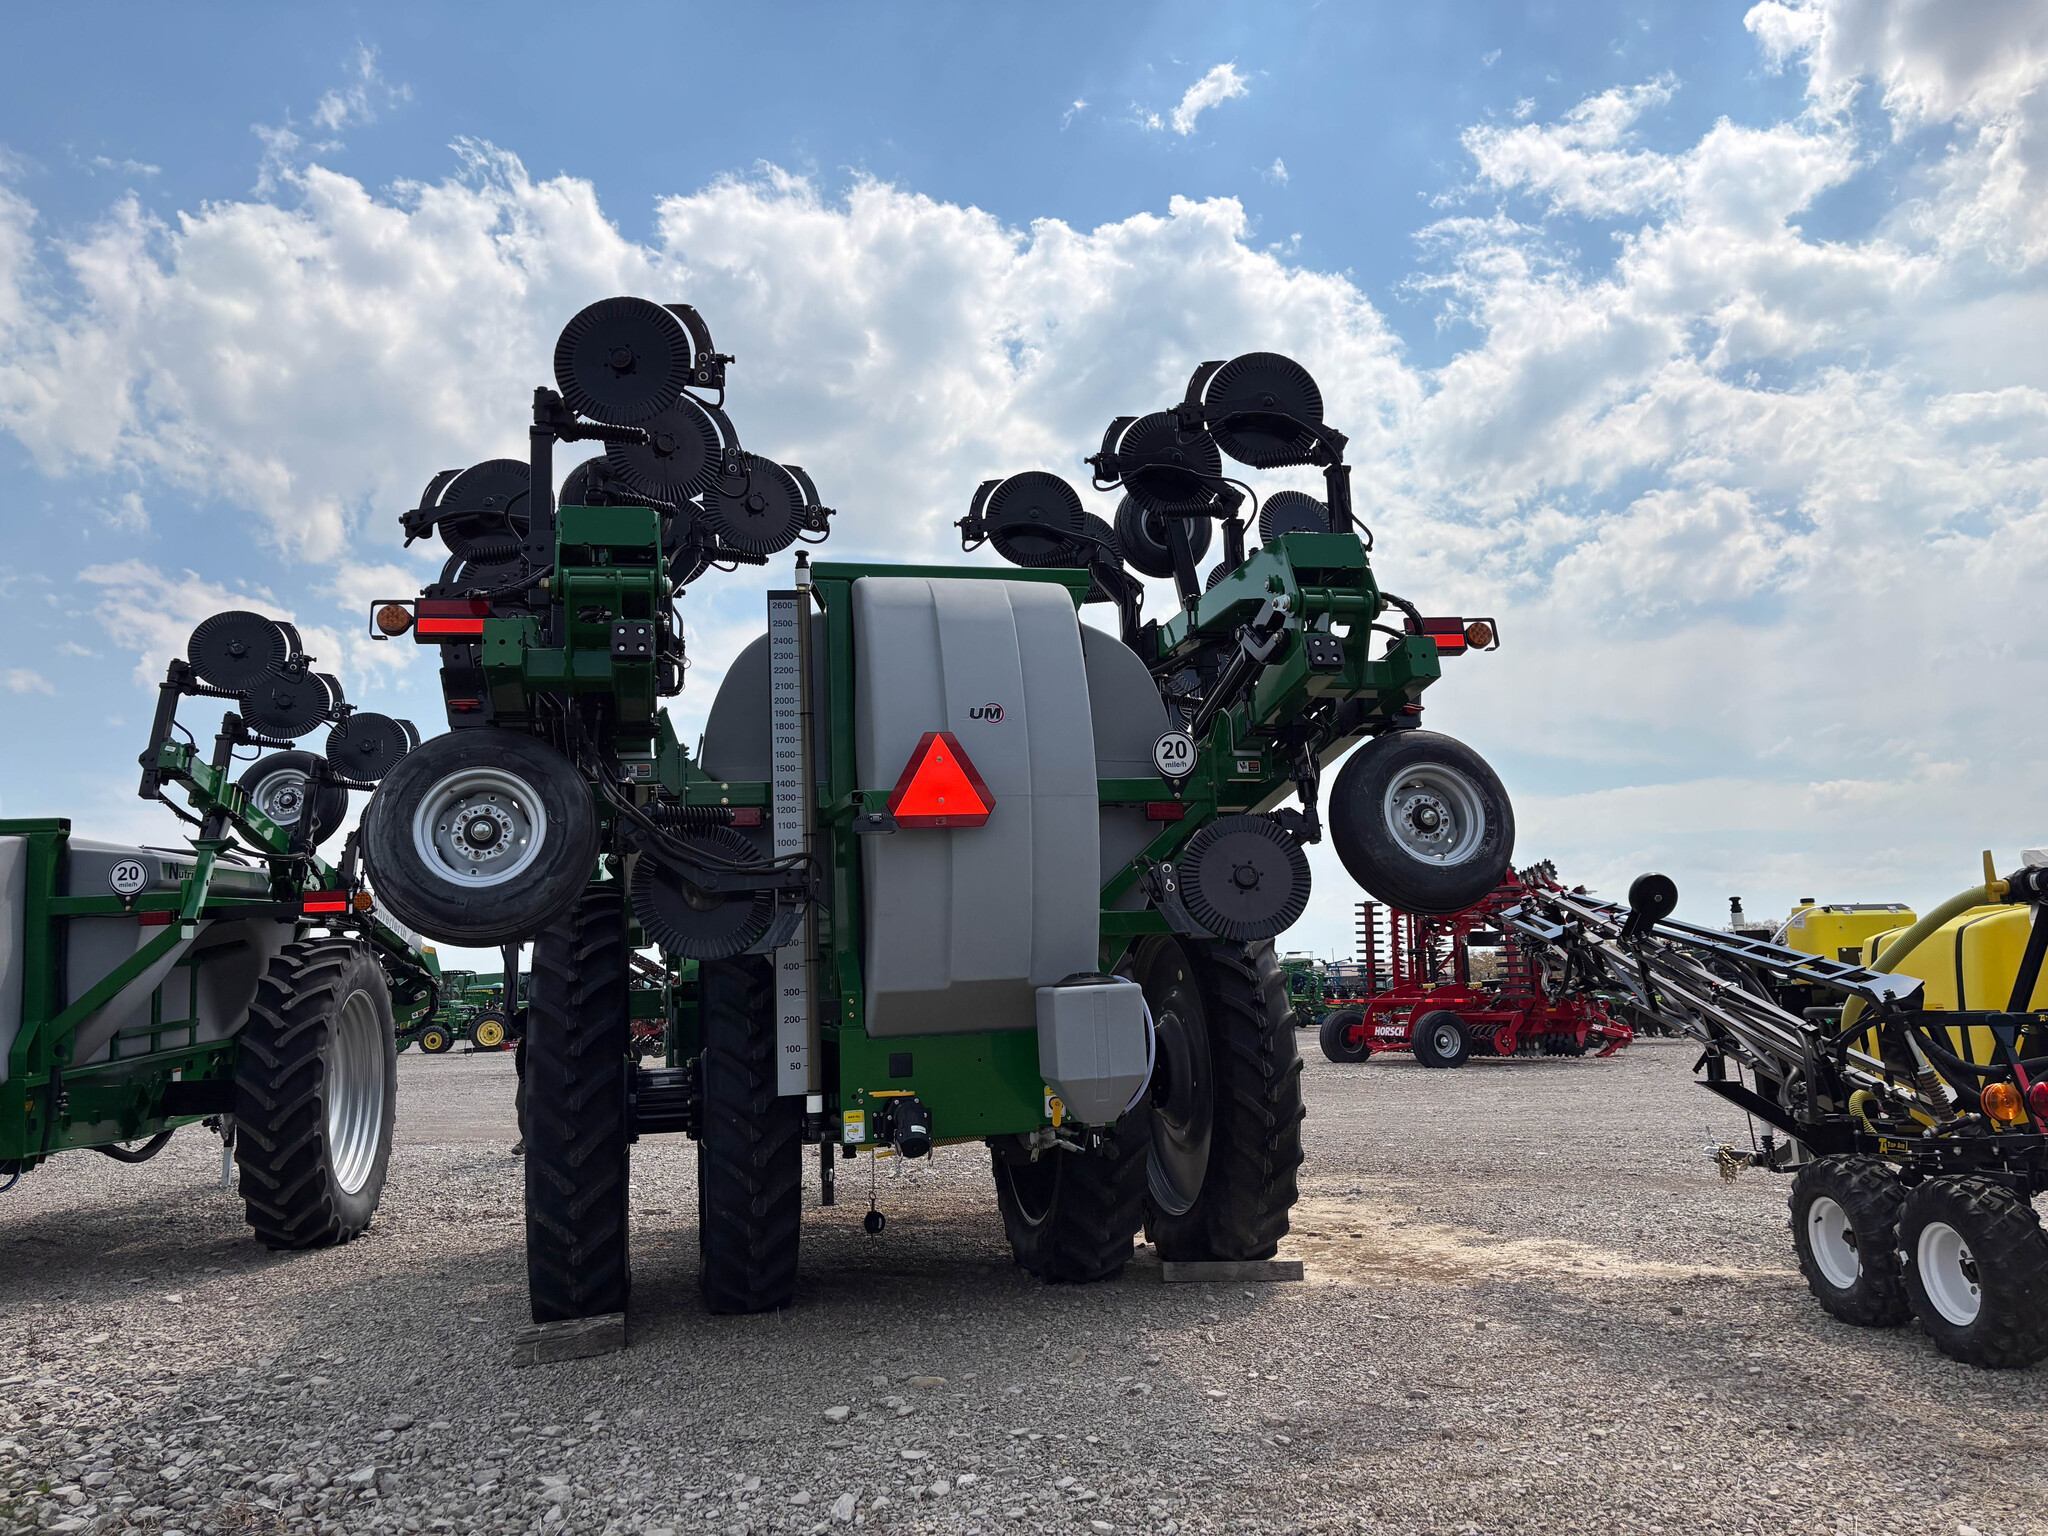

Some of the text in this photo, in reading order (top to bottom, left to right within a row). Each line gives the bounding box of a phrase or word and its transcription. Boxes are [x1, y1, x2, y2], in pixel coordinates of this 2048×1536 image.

[772, 601, 793, 609] 2600
[773, 637, 794, 645] 2400
[773, 652, 794, 660] 2300
[773, 666, 794, 674] 2200
[774, 682, 795, 690] 2100
[774, 697, 795, 705] 2000
[774, 709, 795, 717] 1900
[969, 706, 1002, 720] UM
[775, 722, 795, 730] 1800
[775, 736, 796, 744] 1700
[1162, 740, 1187, 759] 20
[775, 764, 796, 772] 1500
[776, 780, 796, 788] 1400
[776, 794, 797, 802] 1300
[776, 806, 797, 814] 1200
[777, 821, 797, 829] 1100
[777, 839, 798, 847] 1000
[117, 866, 139, 881] 20
[783, 962, 800, 971] 400
[783, 988, 800, 997] 300
[783, 1015, 801, 1024] 200
[1374, 1026, 1405, 1037] HORSCH
[785, 1044, 801, 1053] 100
[790, 1062, 801, 1070] 50
